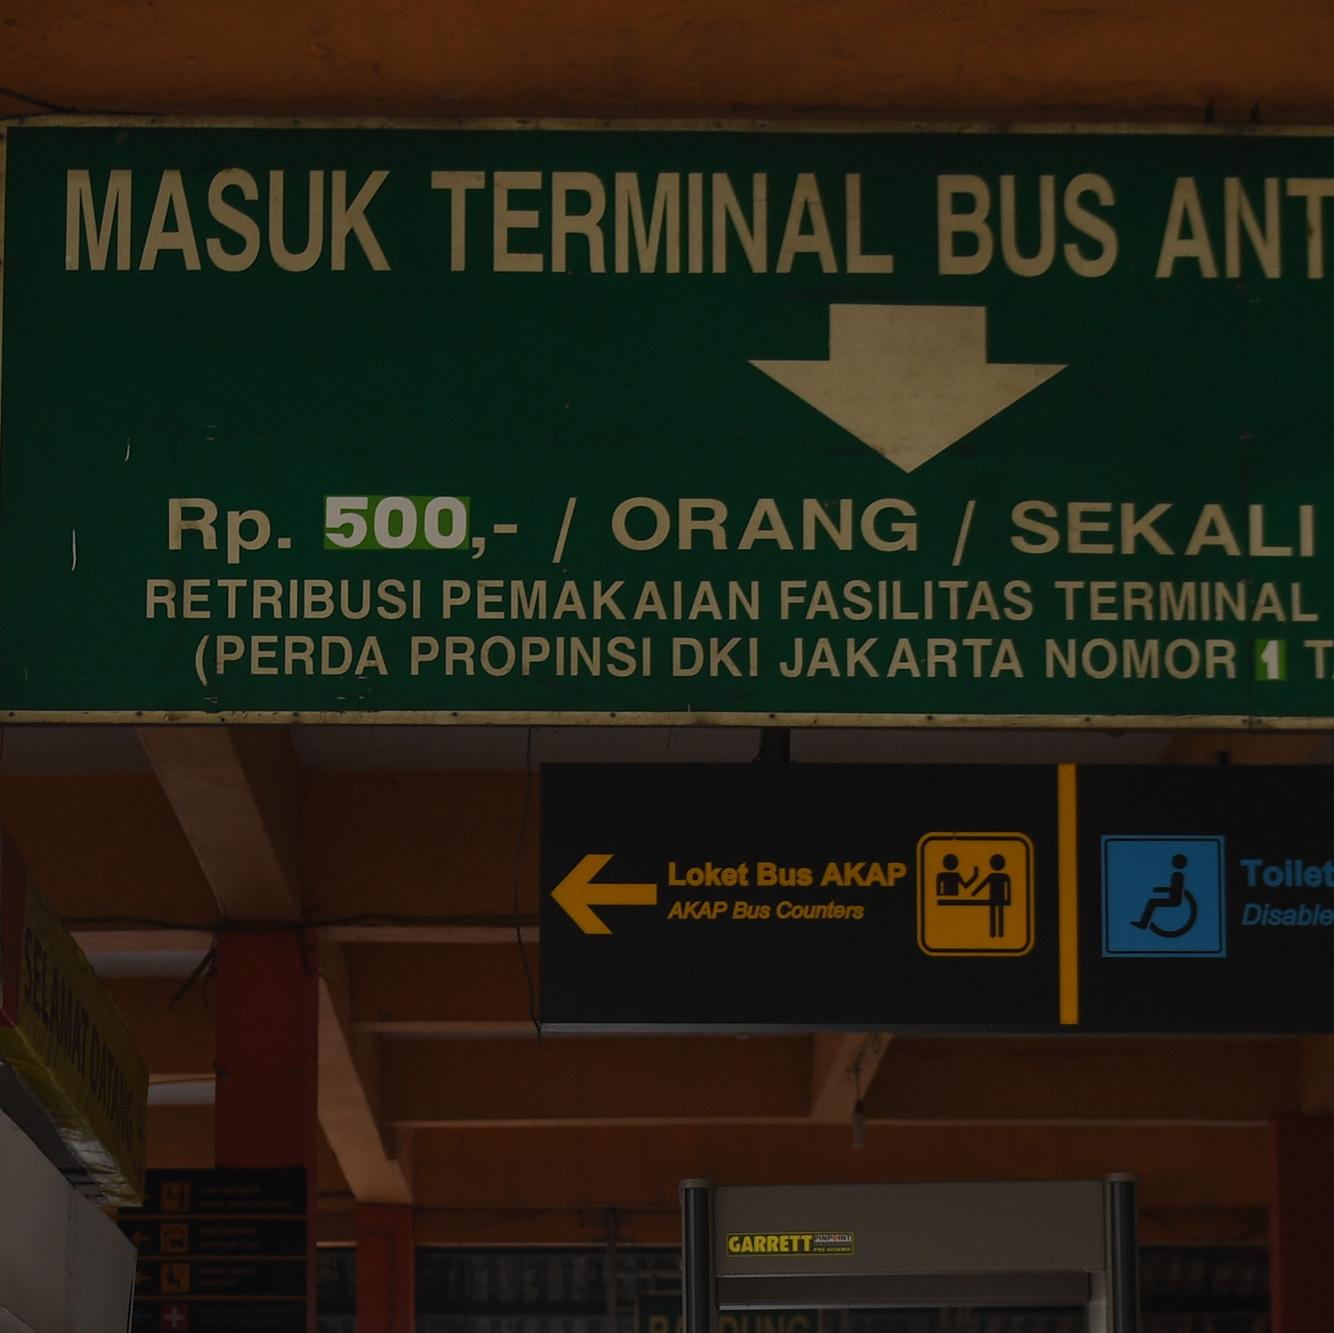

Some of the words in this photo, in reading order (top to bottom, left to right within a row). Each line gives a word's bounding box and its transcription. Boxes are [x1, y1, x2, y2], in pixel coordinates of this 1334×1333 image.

[66, 168, 391, 272] MASUK
[431, 171, 895, 275] TERMINAL
[937, 173, 1119, 277] BUS
[168, 497, 294, 564] Rp.
[324, 496, 519, 560] 500,-
[552, 497, 577, 563] /
[611, 497, 919, 552] ORANG
[951, 501, 976, 566] /
[1010, 500, 1315, 558] SEKALI
[145, 579, 423, 620] RETRIBUSI
[441, 579, 763, 621] PEMAKAIAN
[779, 580, 1035, 622] FASILITAS
[1055, 581, 1320, 623] TERMINAL
[194, 636, 389, 686] (PERDA
[409, 636, 653, 678] PROPINSI
[672, 637, 760, 678] DKI
[779, 637, 1021, 680] JAKARTA
[1045, 639, 1238, 680] NOMOR
[1258, 640, 1283, 680] 1
[667, 861, 747, 888] Loket
[755, 862, 815, 888] Bus
[820, 862, 908, 888] AKAP
[1240, 859, 1334, 888] Toilet
[666, 902, 728, 920] AKAP
[732, 902, 772, 921] Bus
[776, 902, 866, 921] Counters
[728, 1235, 813, 1253] GARRETT
